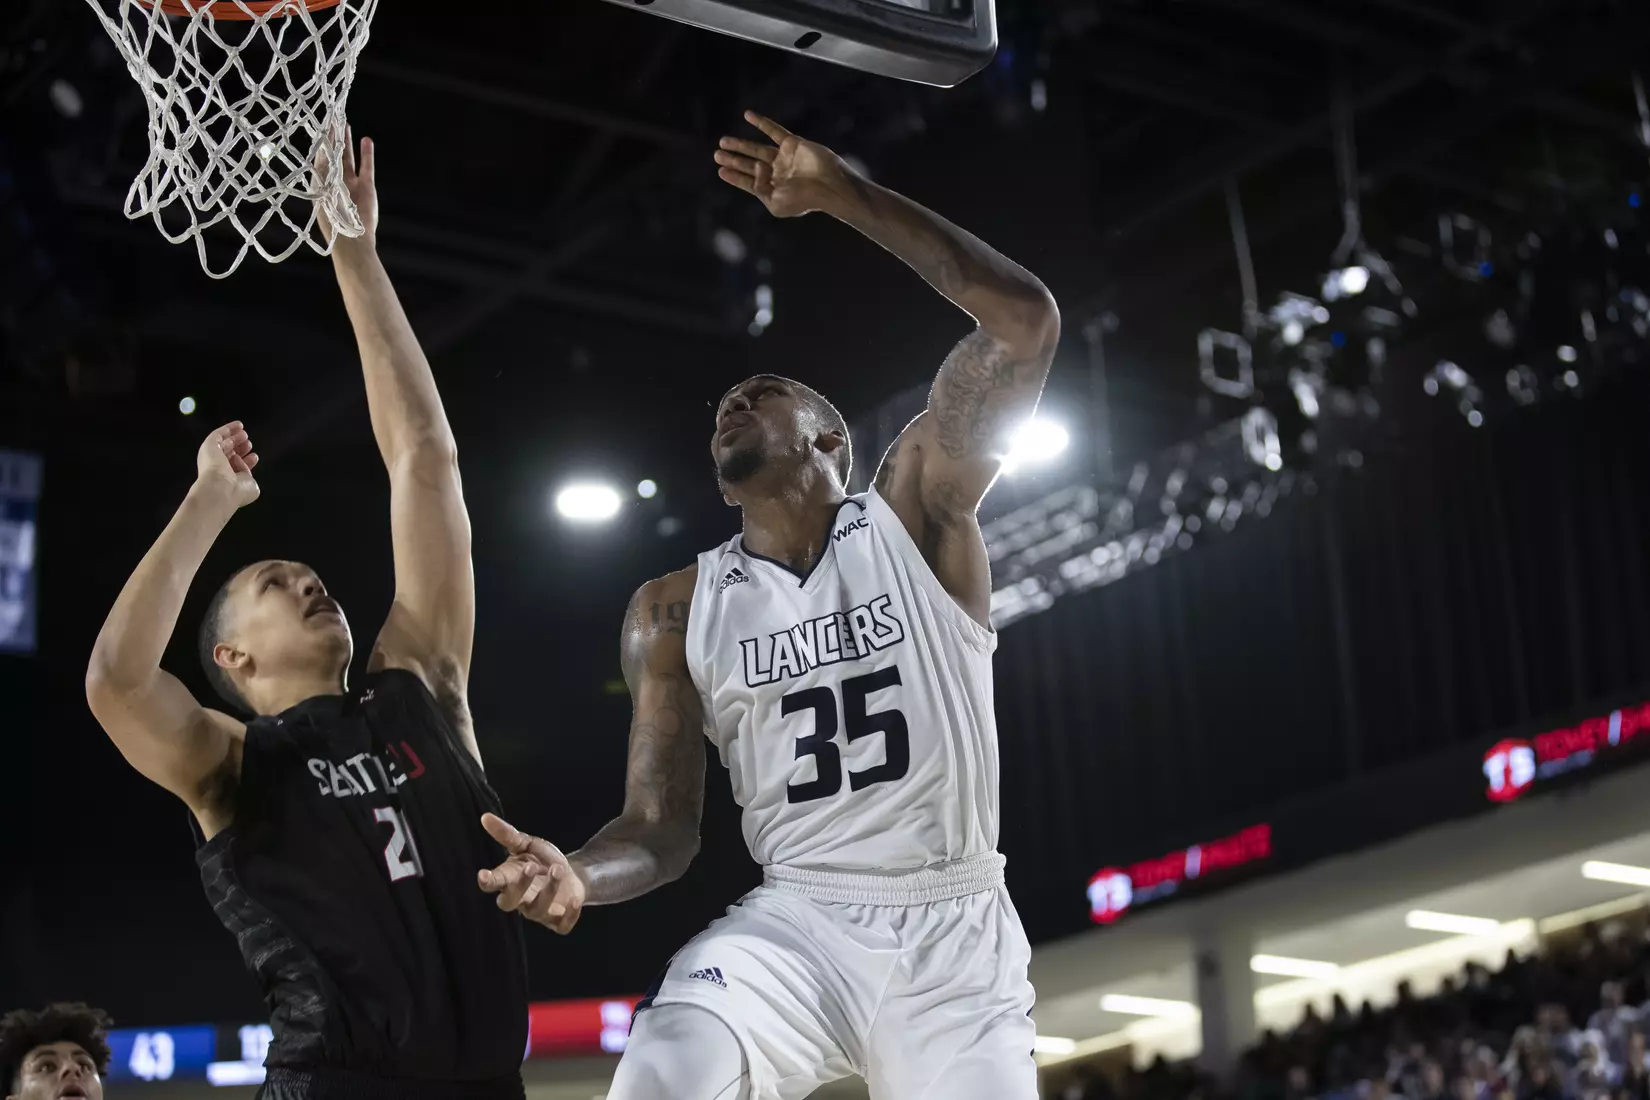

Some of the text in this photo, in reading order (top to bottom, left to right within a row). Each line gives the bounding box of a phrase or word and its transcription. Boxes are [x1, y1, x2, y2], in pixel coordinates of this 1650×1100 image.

[832, 517, 869, 542] WAC
[719, 574, 750, 594] adidas
[739, 594, 905, 688] LANCERS
[781, 665, 910, 804] 35
[688, 972, 728, 988] adidas
